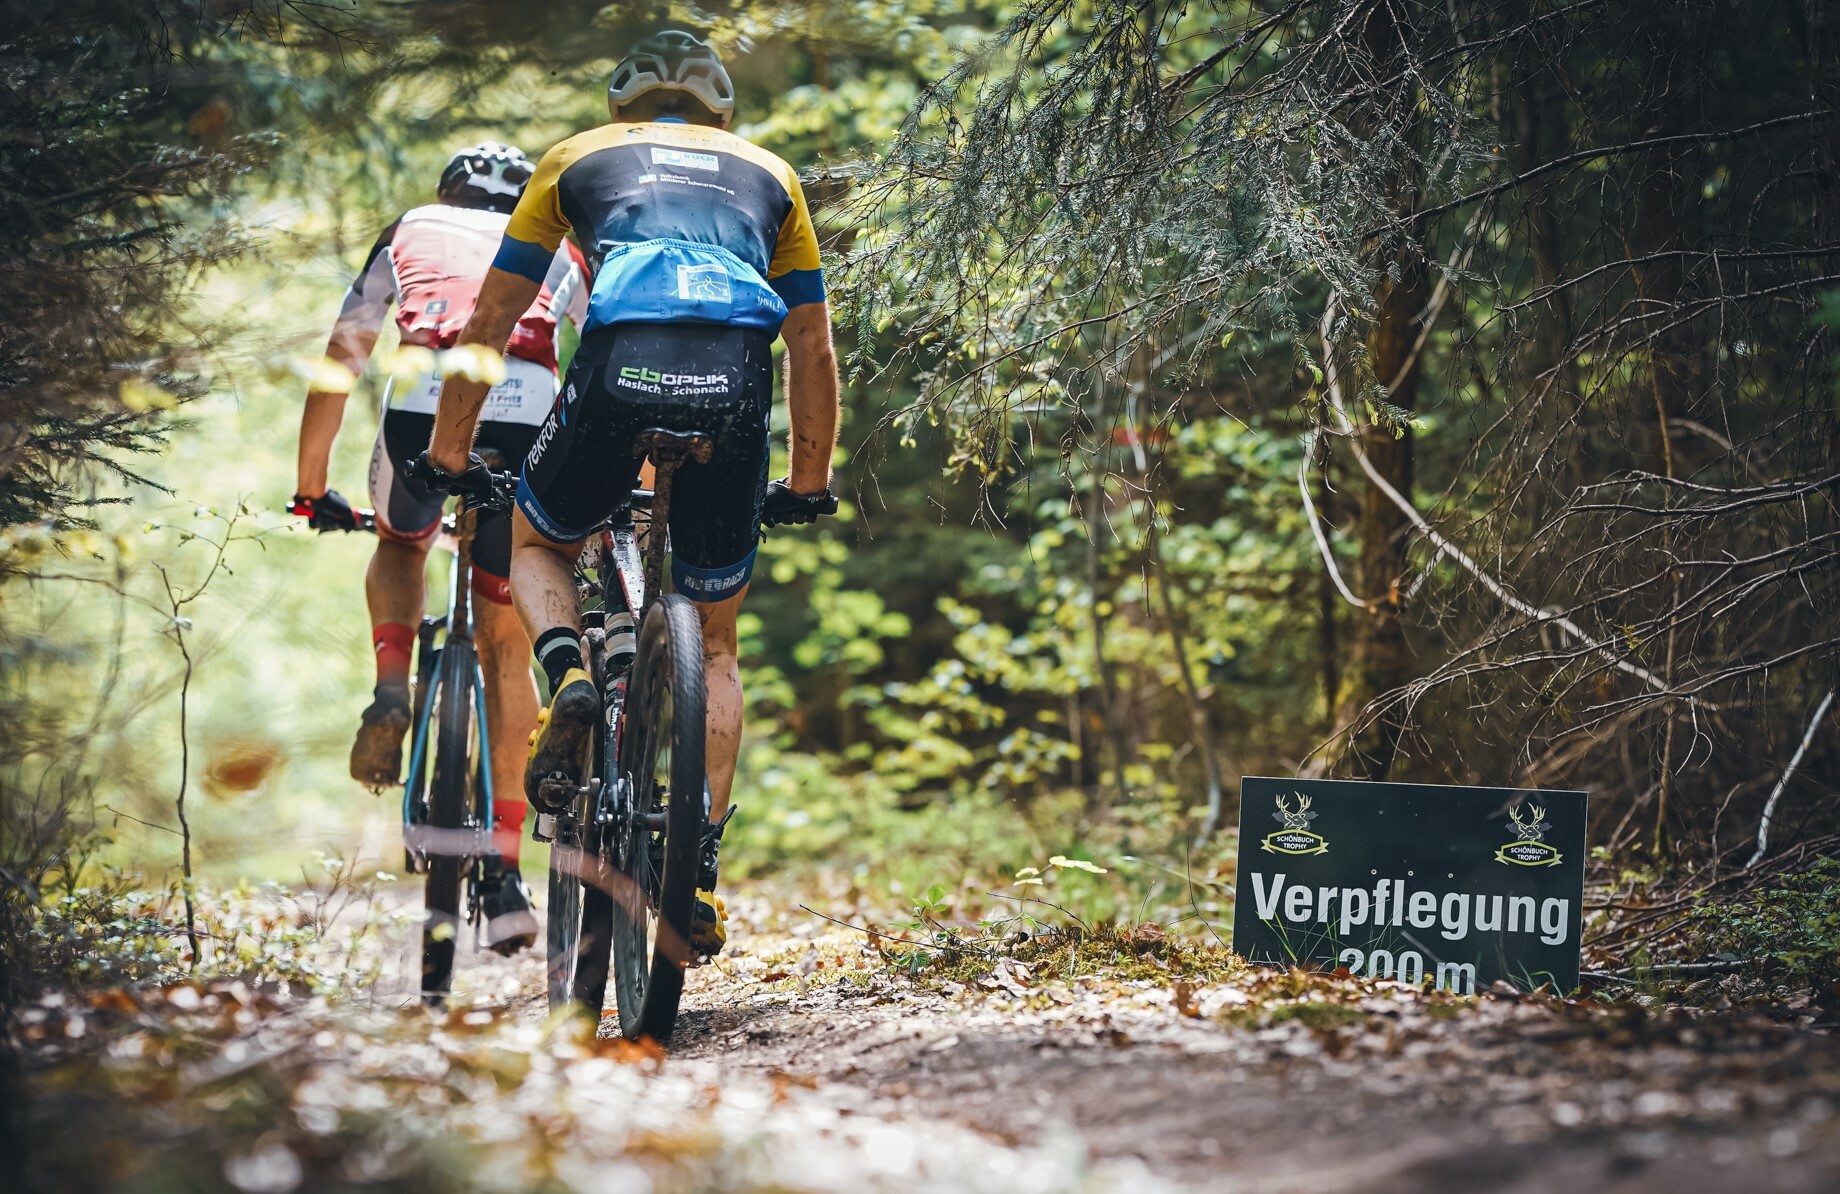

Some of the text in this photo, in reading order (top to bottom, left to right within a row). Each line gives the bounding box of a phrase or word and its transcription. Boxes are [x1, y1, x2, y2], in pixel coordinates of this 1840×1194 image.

[617, 377, 729, 396] Haslach Schonach
[1276, 834, 1315, 843] SCHÖNBUCH
[1510, 845, 1548, 855] SCHÖNBUCH
[1250, 871, 1570, 946] Verpflegung
[1339, 947, 1476, 995] 200 m
